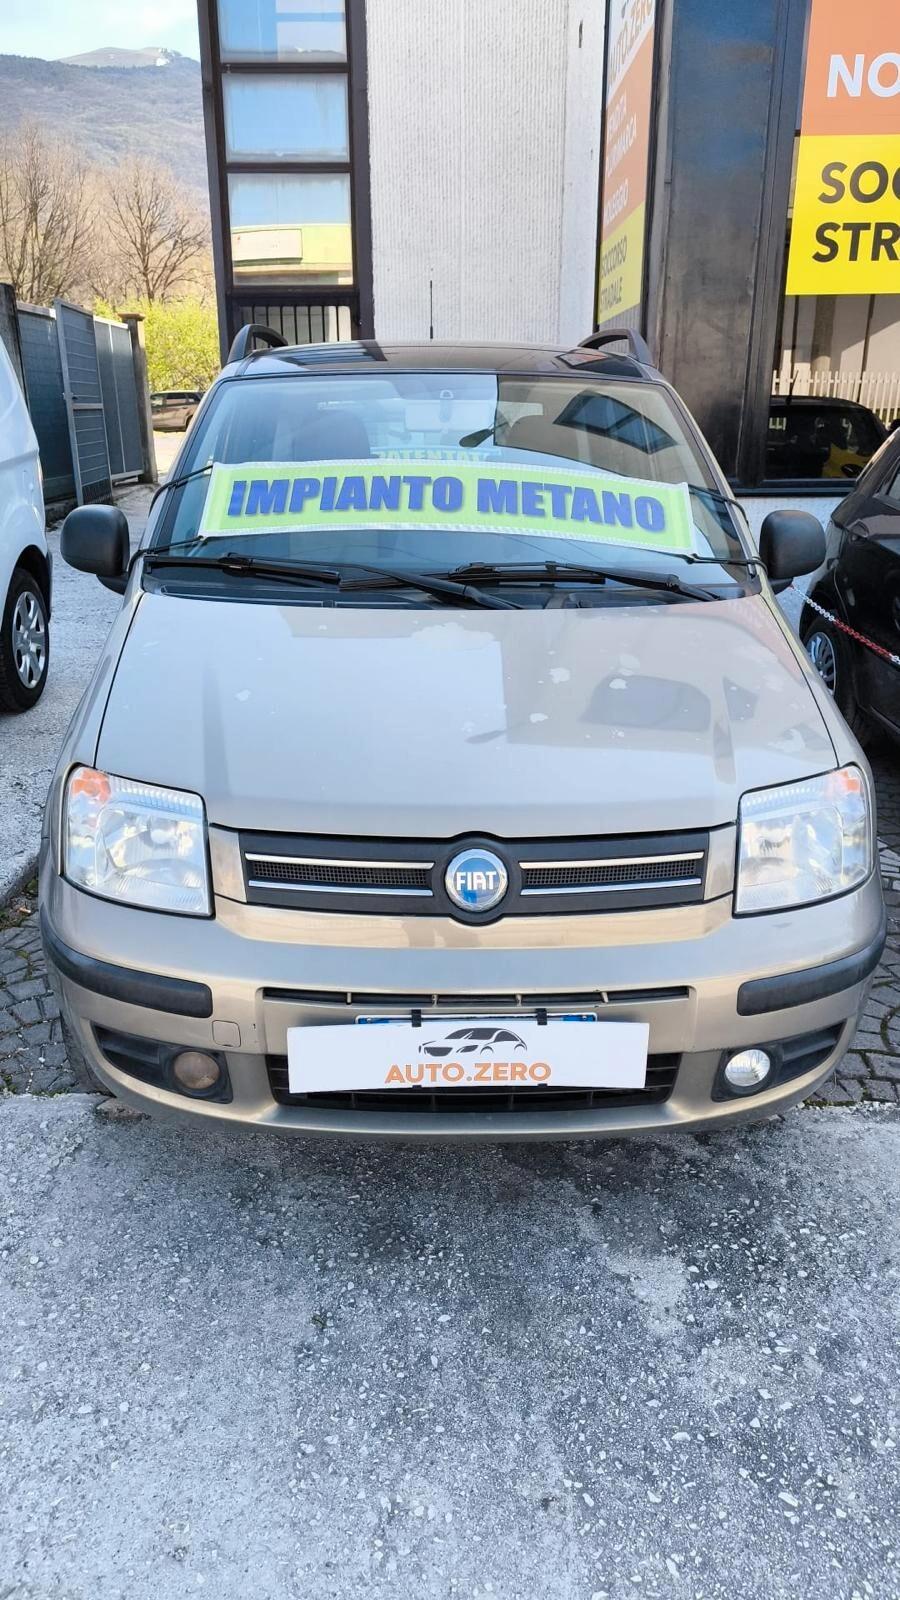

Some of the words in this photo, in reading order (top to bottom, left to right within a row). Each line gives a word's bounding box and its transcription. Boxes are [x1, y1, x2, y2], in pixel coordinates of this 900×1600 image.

[600, 235, 628, 280] SOCCORSO
[599, 276, 623, 313] STRADALE
[228, 475, 464, 518] IMPIANTO
[477, 479, 666, 532] METANO
[455, 870, 497, 891] FIAT
[384, 1062, 552, 1084] AUTO.ZERO
